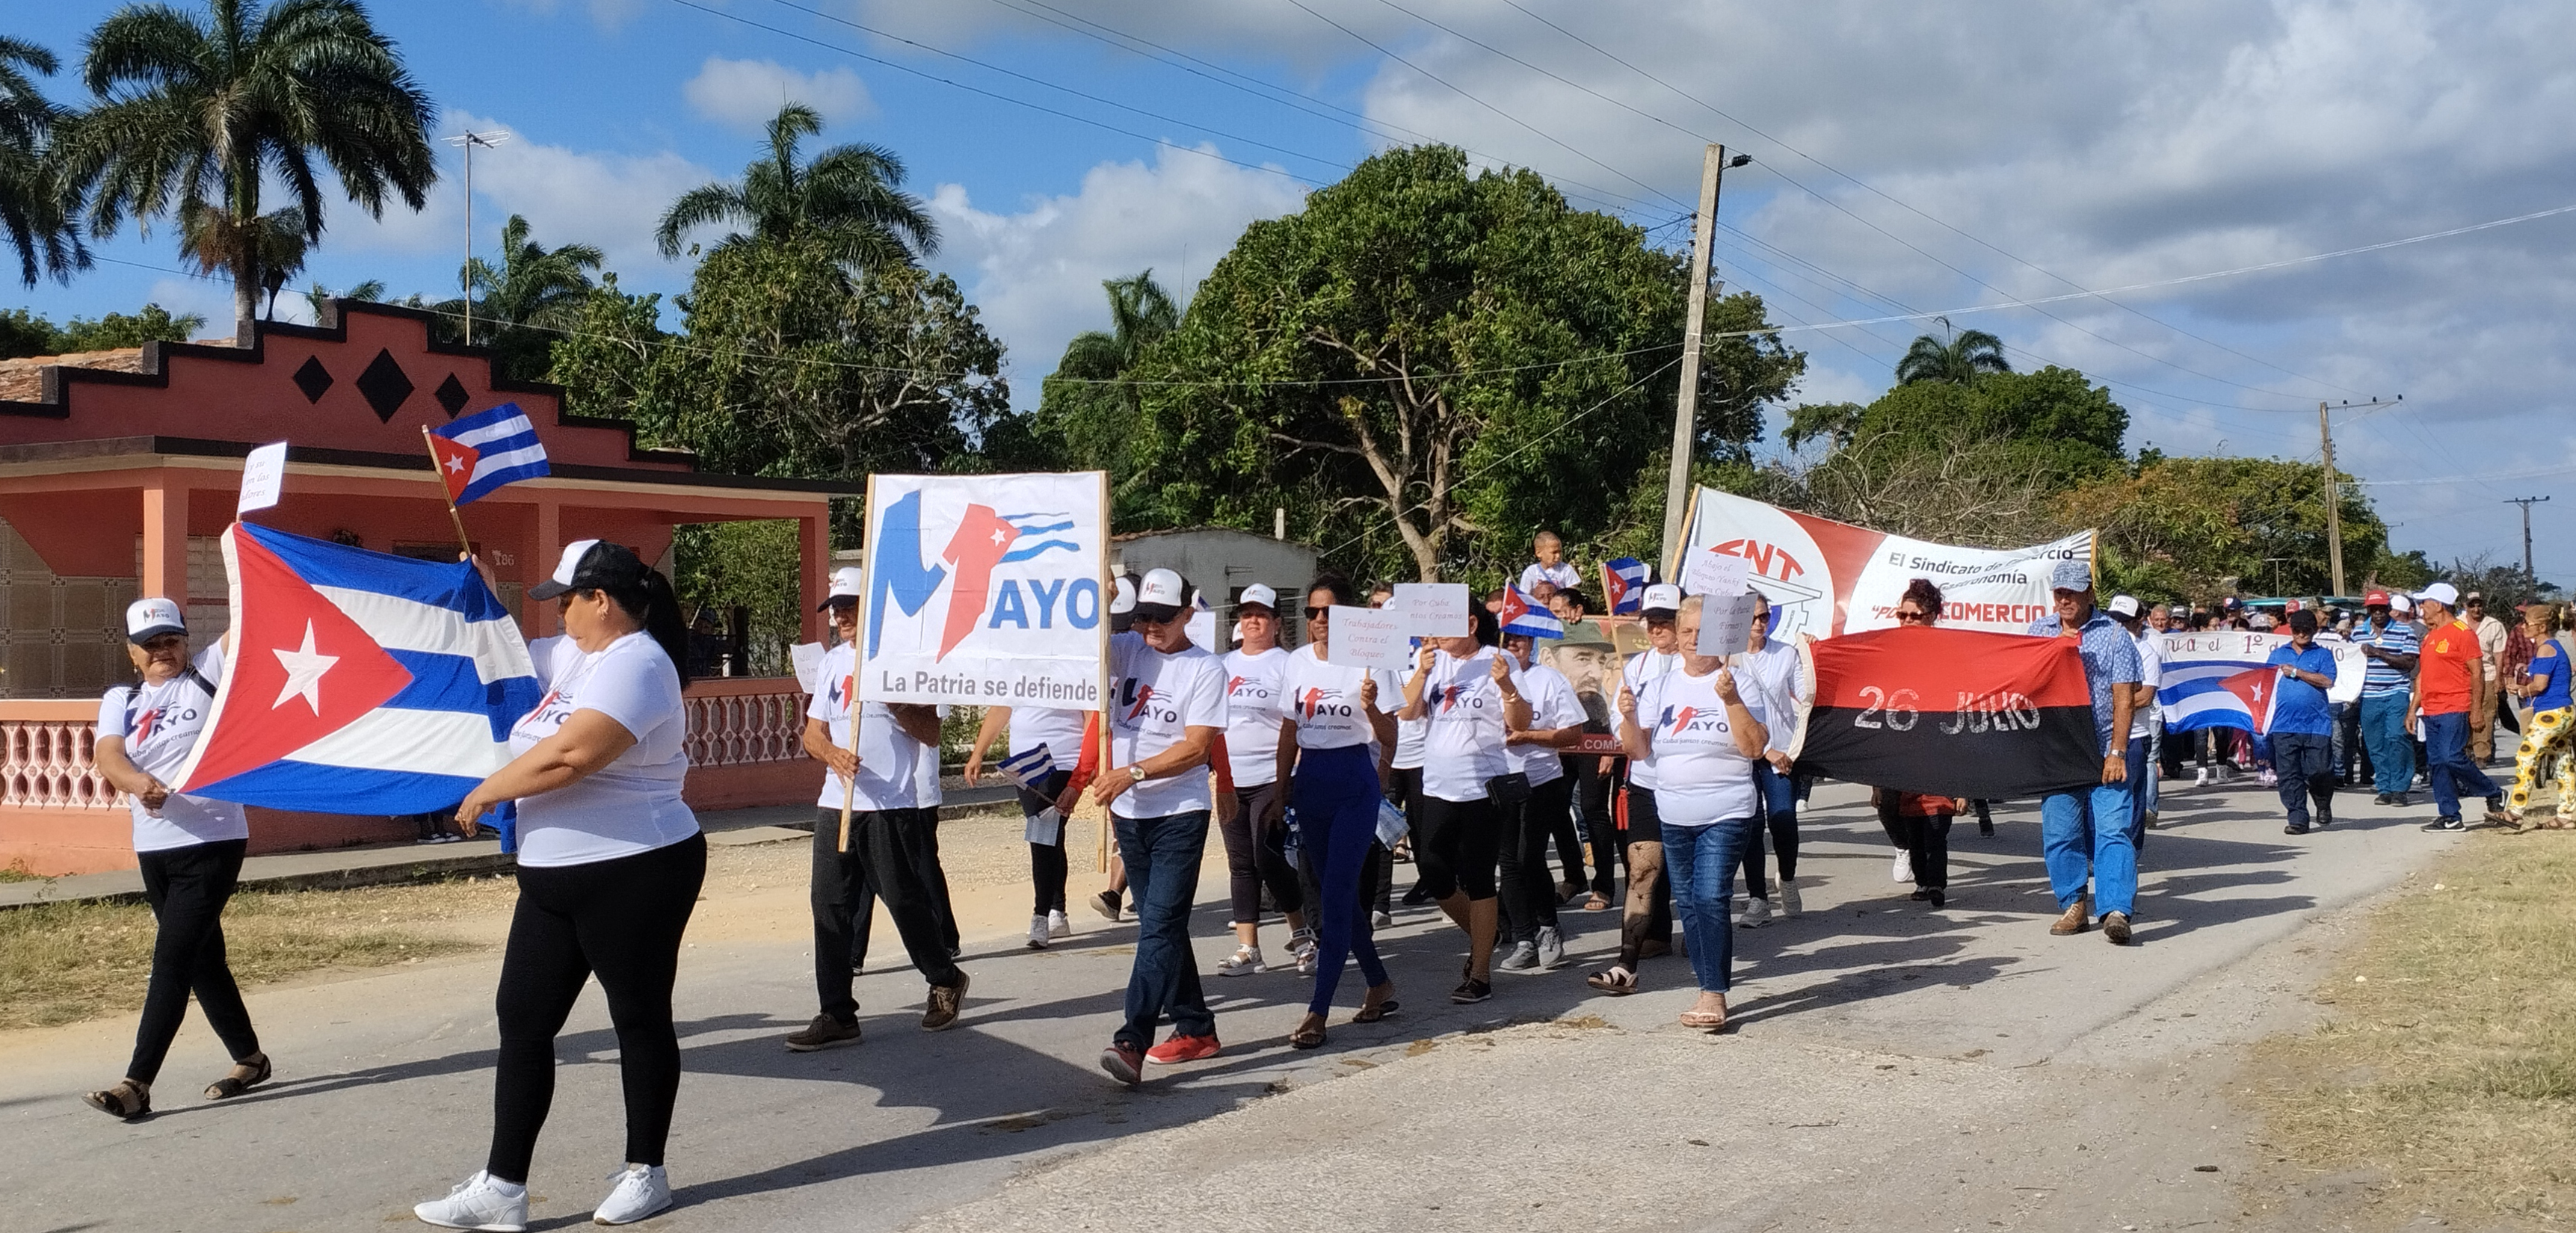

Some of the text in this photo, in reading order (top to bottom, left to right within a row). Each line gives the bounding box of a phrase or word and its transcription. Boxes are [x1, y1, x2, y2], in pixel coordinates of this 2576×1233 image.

[1889, 551, 1905, 567] El
[1909, 556, 1982, 575] Sindicato
[1984, 562, 2003, 572] de
[1429, 598, 1449, 608] Cuba
[1342, 617, 1399, 631] Trabajadores
[1348, 634, 1390, 644] Contra el
[2207, 637, 2225, 652] el
[1350, 648, 1385, 661] Bloqueo
[882, 670, 1097, 702] La Patria se defiende
[1854, 685, 2041, 735] 26 JULIO
